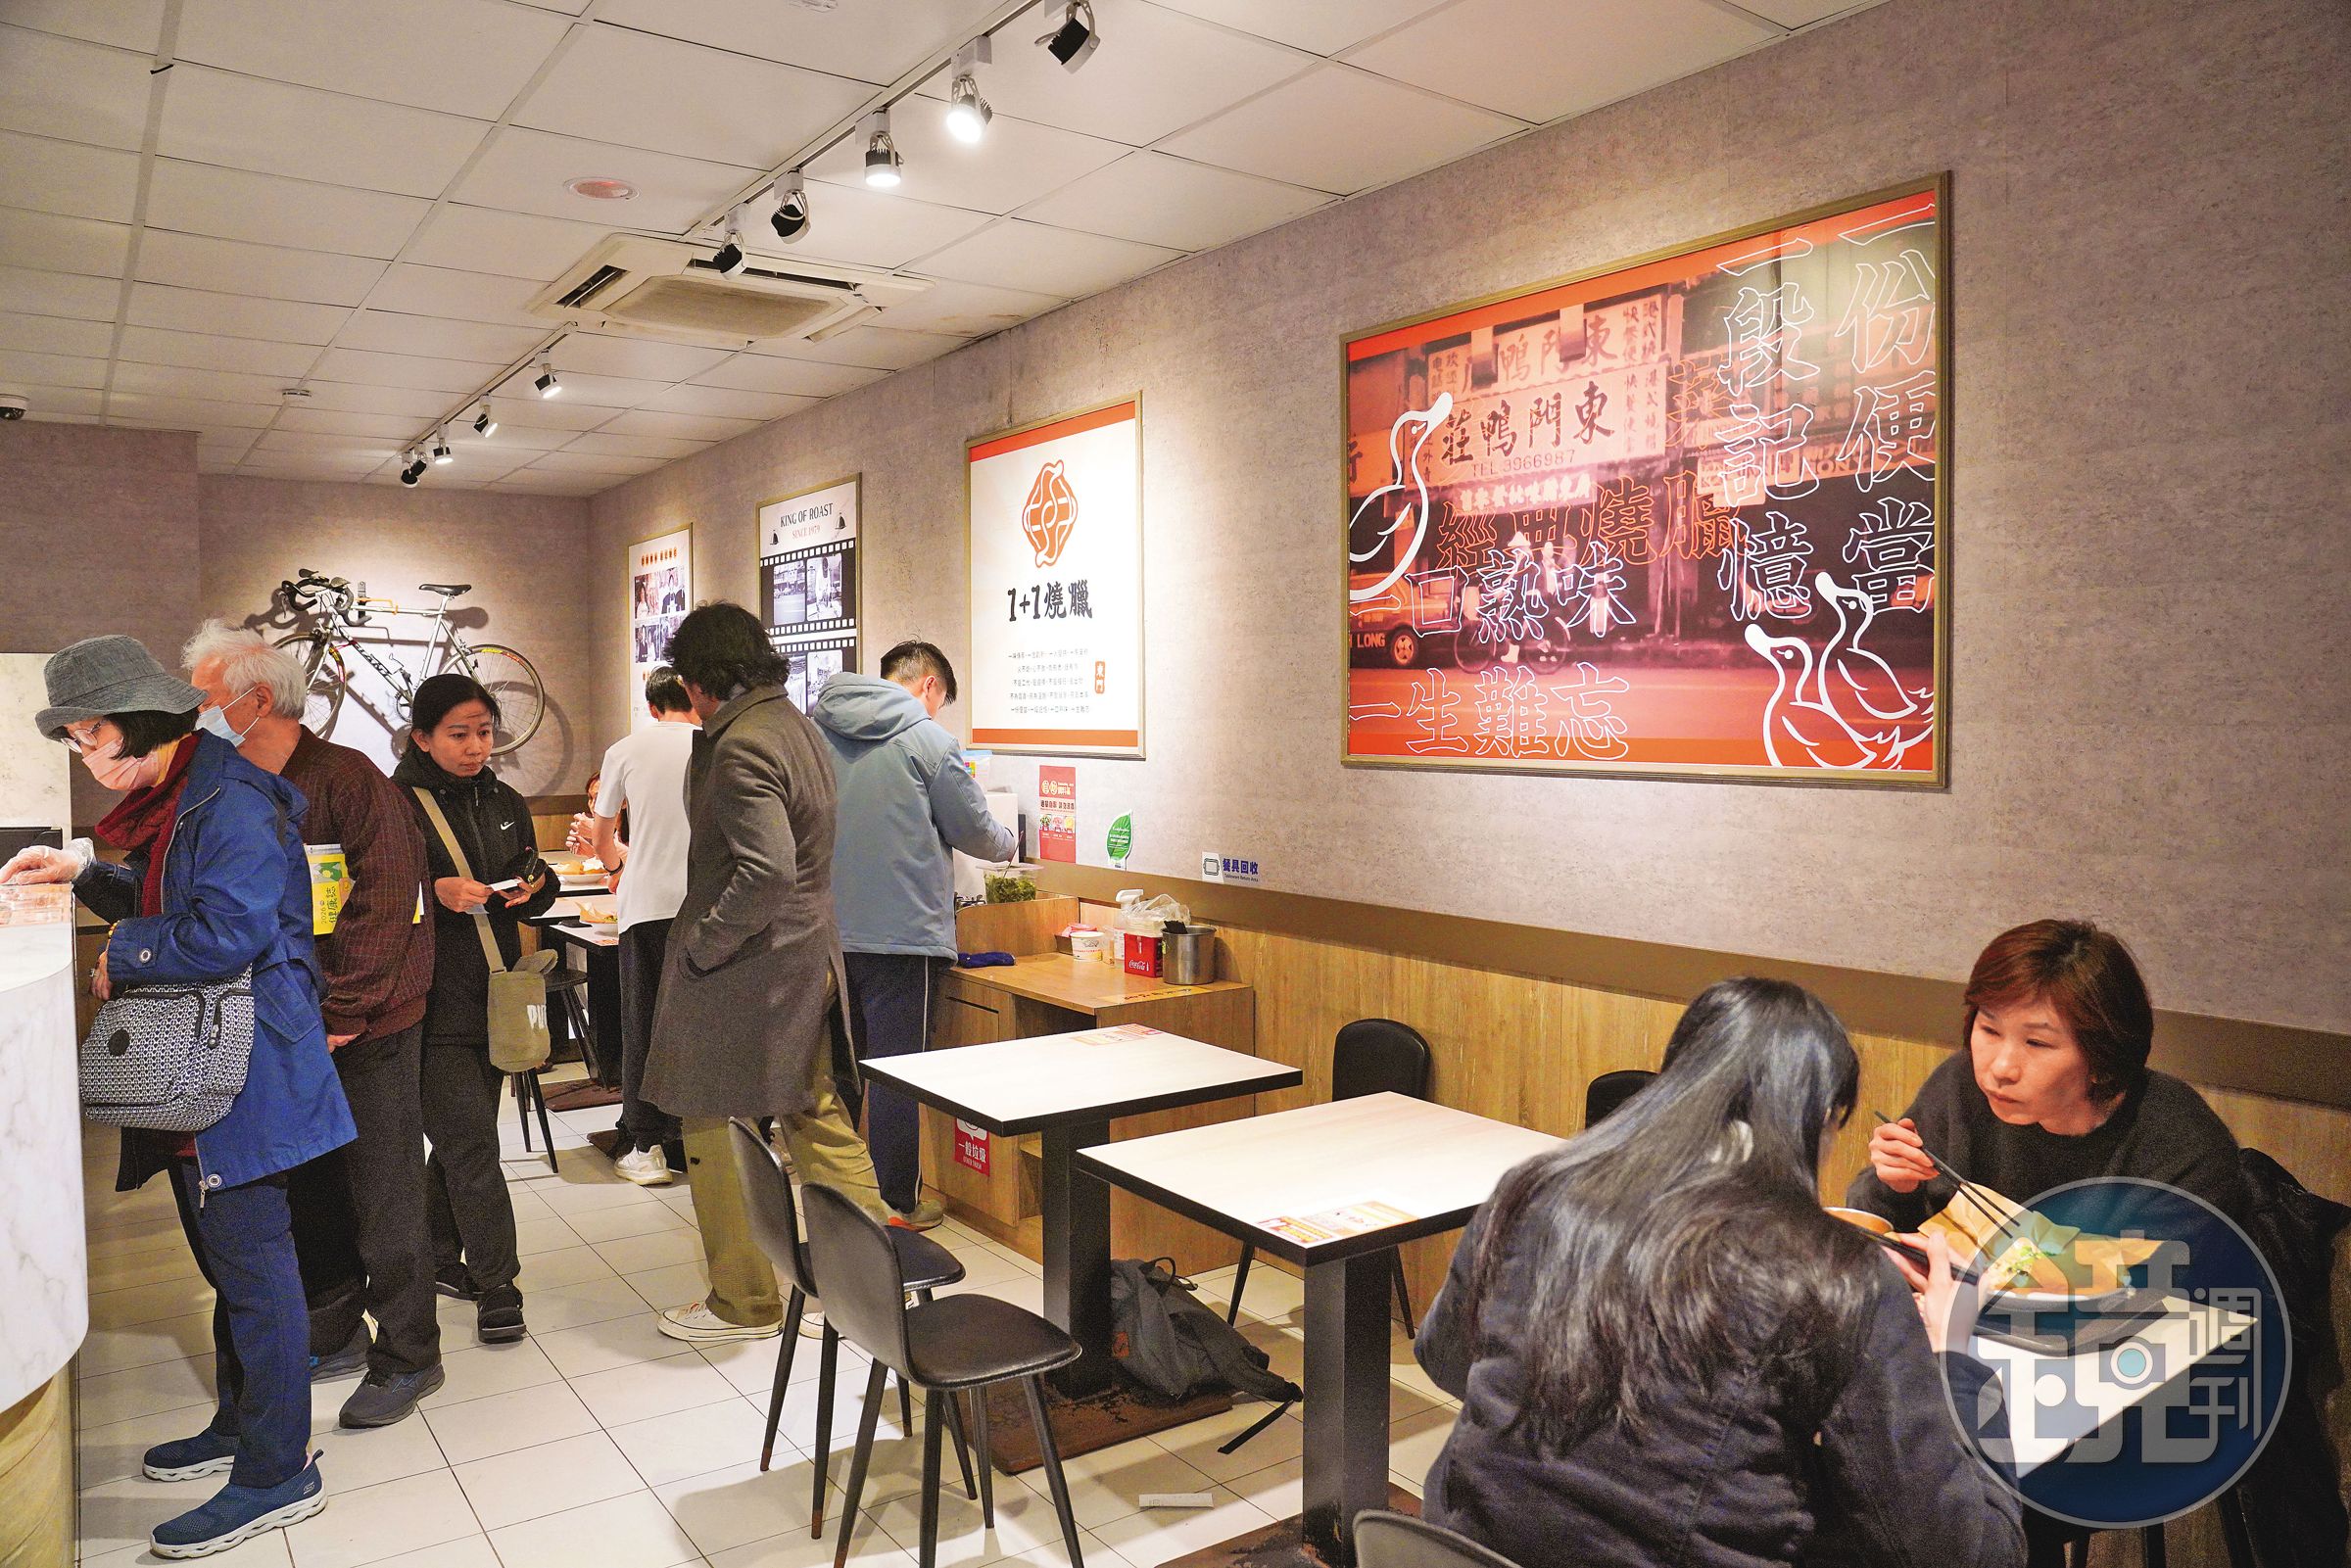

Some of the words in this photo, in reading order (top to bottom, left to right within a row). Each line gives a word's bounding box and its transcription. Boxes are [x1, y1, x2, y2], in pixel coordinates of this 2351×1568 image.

[1716, 238, 1821, 621] 一段記憶
[1835, 204, 1936, 614] 一份便當
[1471, 461, 1501, 478] TEL
[781, 512, 796, 527] KING
[798, 509, 807, 523] OF
[809, 502, 834, 520] ROAST
[1007, 579, 1092, 622] 1+1燒臘
[1349, 542, 1637, 643] 一口熟味
[1357, 633, 1386, 648] LONG
[1349, 662, 1630, 760] 一生難忘
[1223, 858, 1259, 875] 餐具回收
